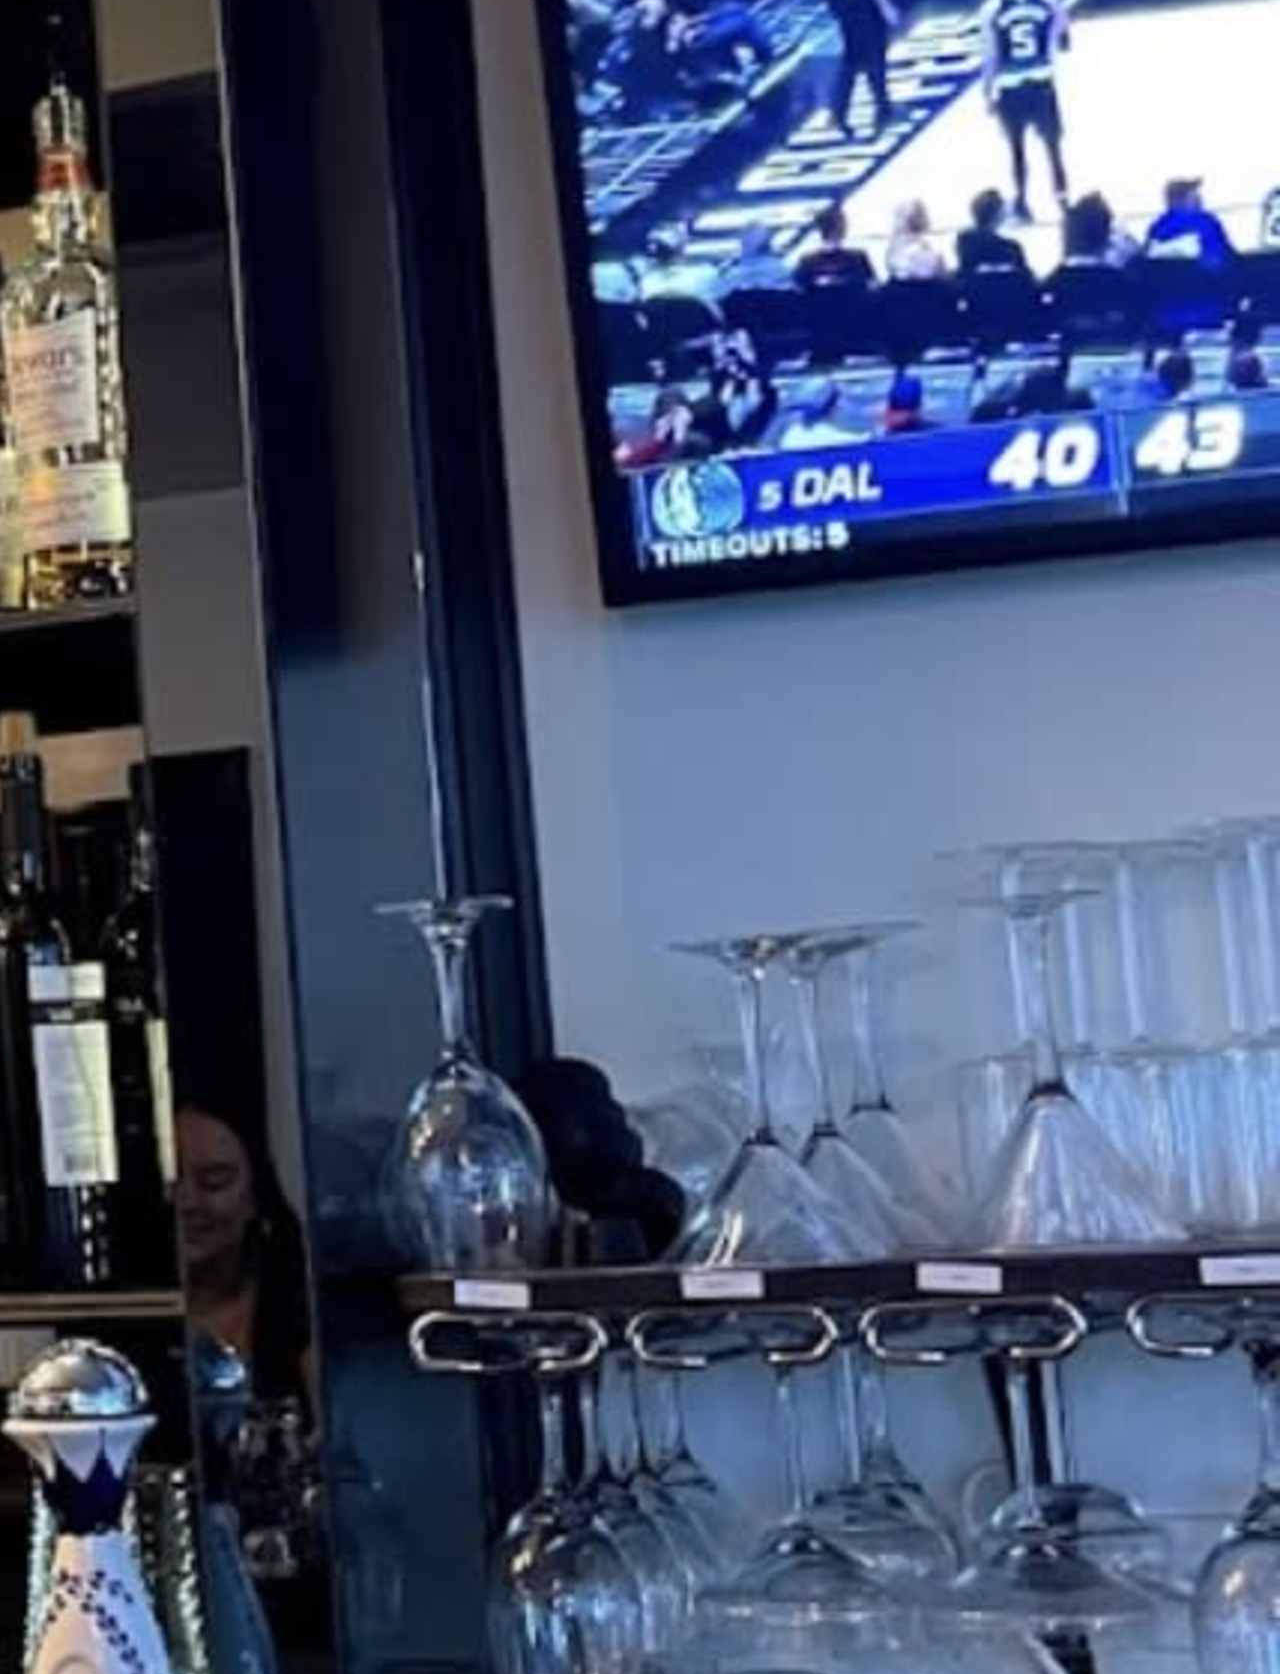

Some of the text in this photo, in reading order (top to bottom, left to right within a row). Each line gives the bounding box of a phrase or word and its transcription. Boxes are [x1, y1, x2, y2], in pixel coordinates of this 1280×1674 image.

[757, 405, 1245, 513] 5 DAL 40 43
